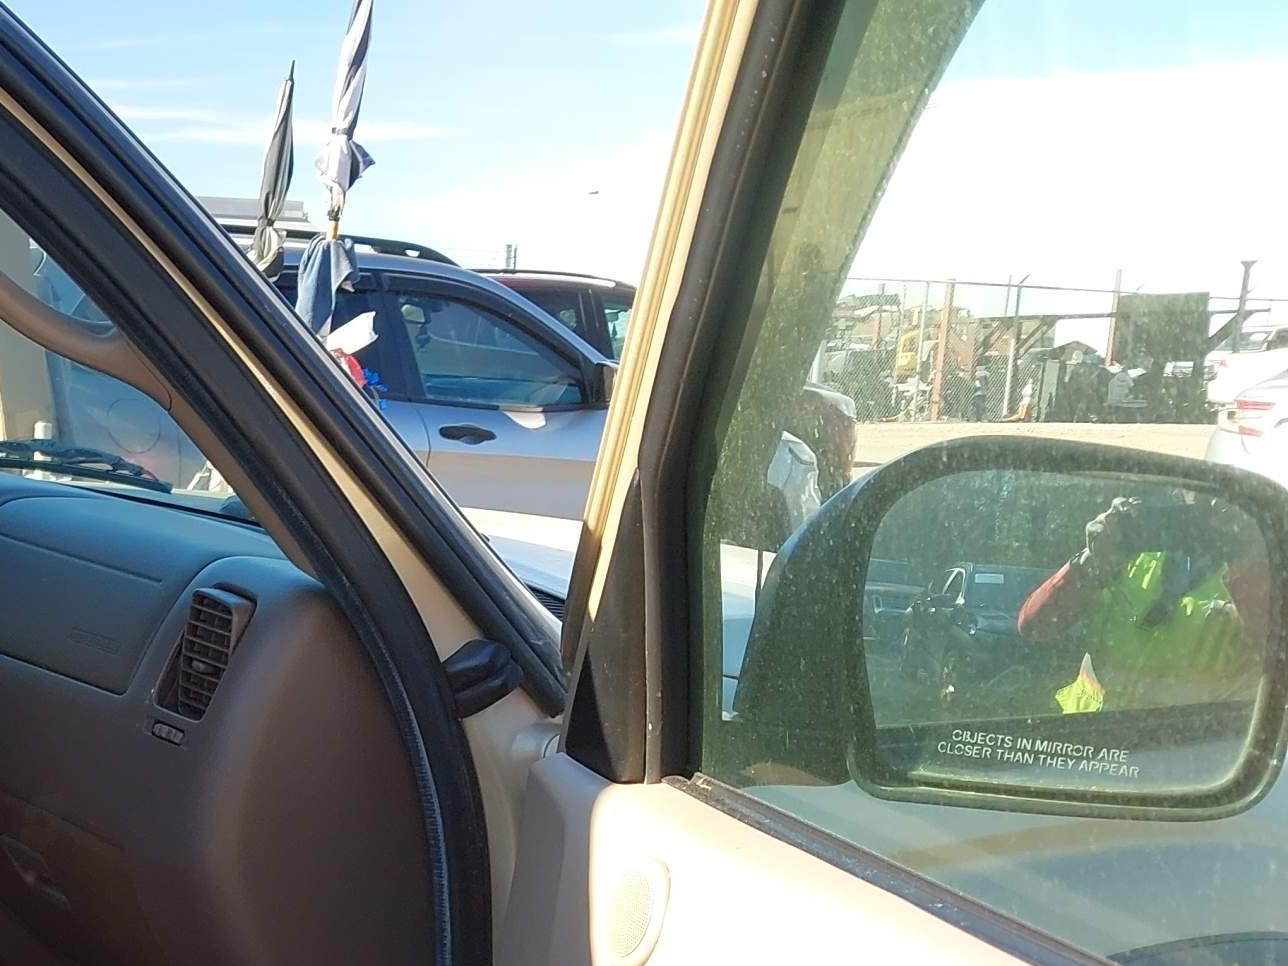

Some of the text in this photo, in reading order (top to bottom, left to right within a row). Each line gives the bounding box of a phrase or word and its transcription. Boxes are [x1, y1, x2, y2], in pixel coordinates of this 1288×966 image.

[937, 741, 1140, 779] CLOSER THAN THEY APPEAR
[951, 729, 1129, 763] OBJECTS IN MIRROR ARE
